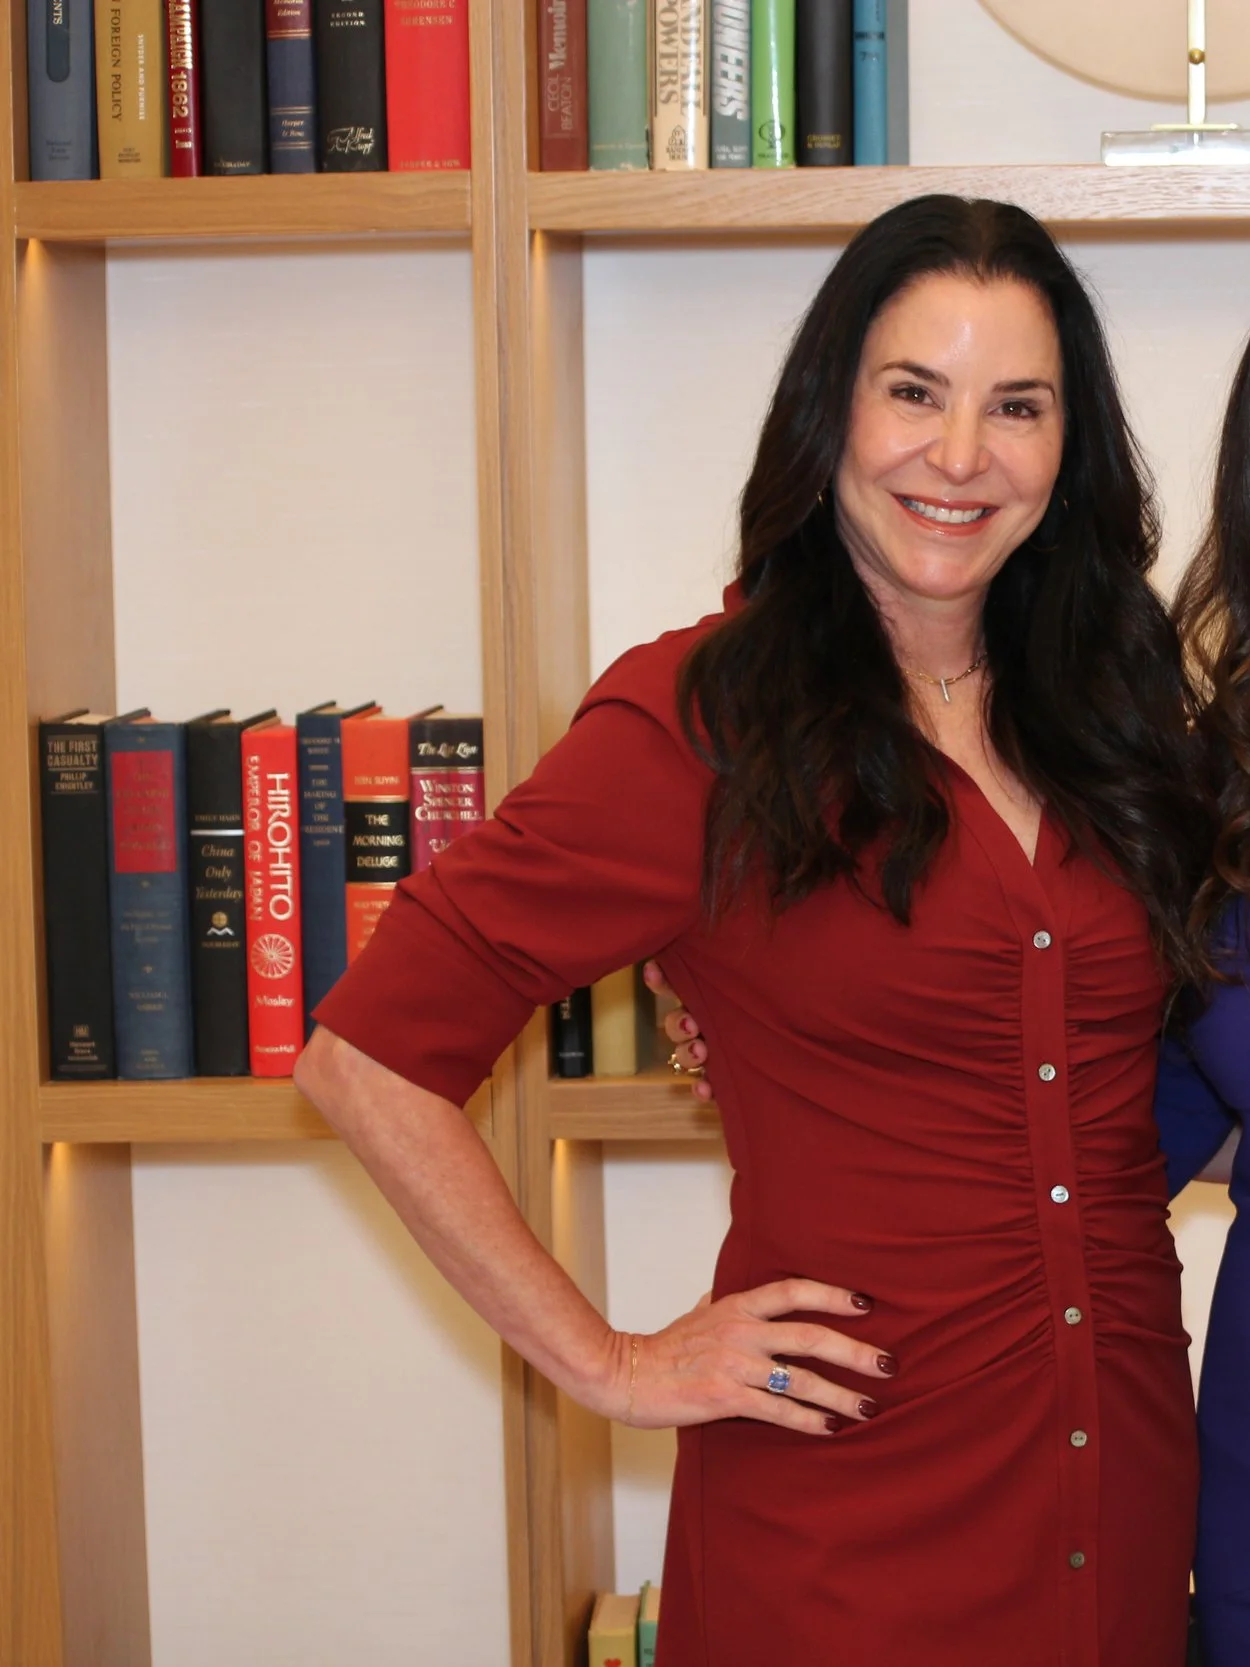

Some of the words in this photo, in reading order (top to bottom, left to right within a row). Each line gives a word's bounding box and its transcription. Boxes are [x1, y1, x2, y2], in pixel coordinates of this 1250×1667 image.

[330, 19, 366, 28] EDITION
[680, 0, 702, 45] ND
[110, 8, 121, 68] FOREIGN
[111, 74, 122, 122] POLICY
[171, 71, 188, 119] 1862
[547, 73, 559, 112] CECIL
[559, 76, 573, 131] BEATON
[47, 741, 66, 753] THE
[68, 740, 97, 753] FIRST
[47, 753, 98, 768] CASUALTY
[60, 771, 87, 781] PHILLIP
[246, 755, 261, 832] EMPEROR
[419, 778, 476, 794] WINSTON
[423, 793, 475, 808] SPENCER
[365, 813, 389, 827] THE
[414, 804, 483, 822] CHURCHILL
[266, 773, 294, 921] HIROHITO
[352, 834, 404, 848] MORNING
[200, 843, 236, 858] China
[248, 840, 262, 862] OF
[356, 855, 399, 869] DELUGE
[205, 865, 232, 882] Only
[195, 886, 243, 902] Yesterday
